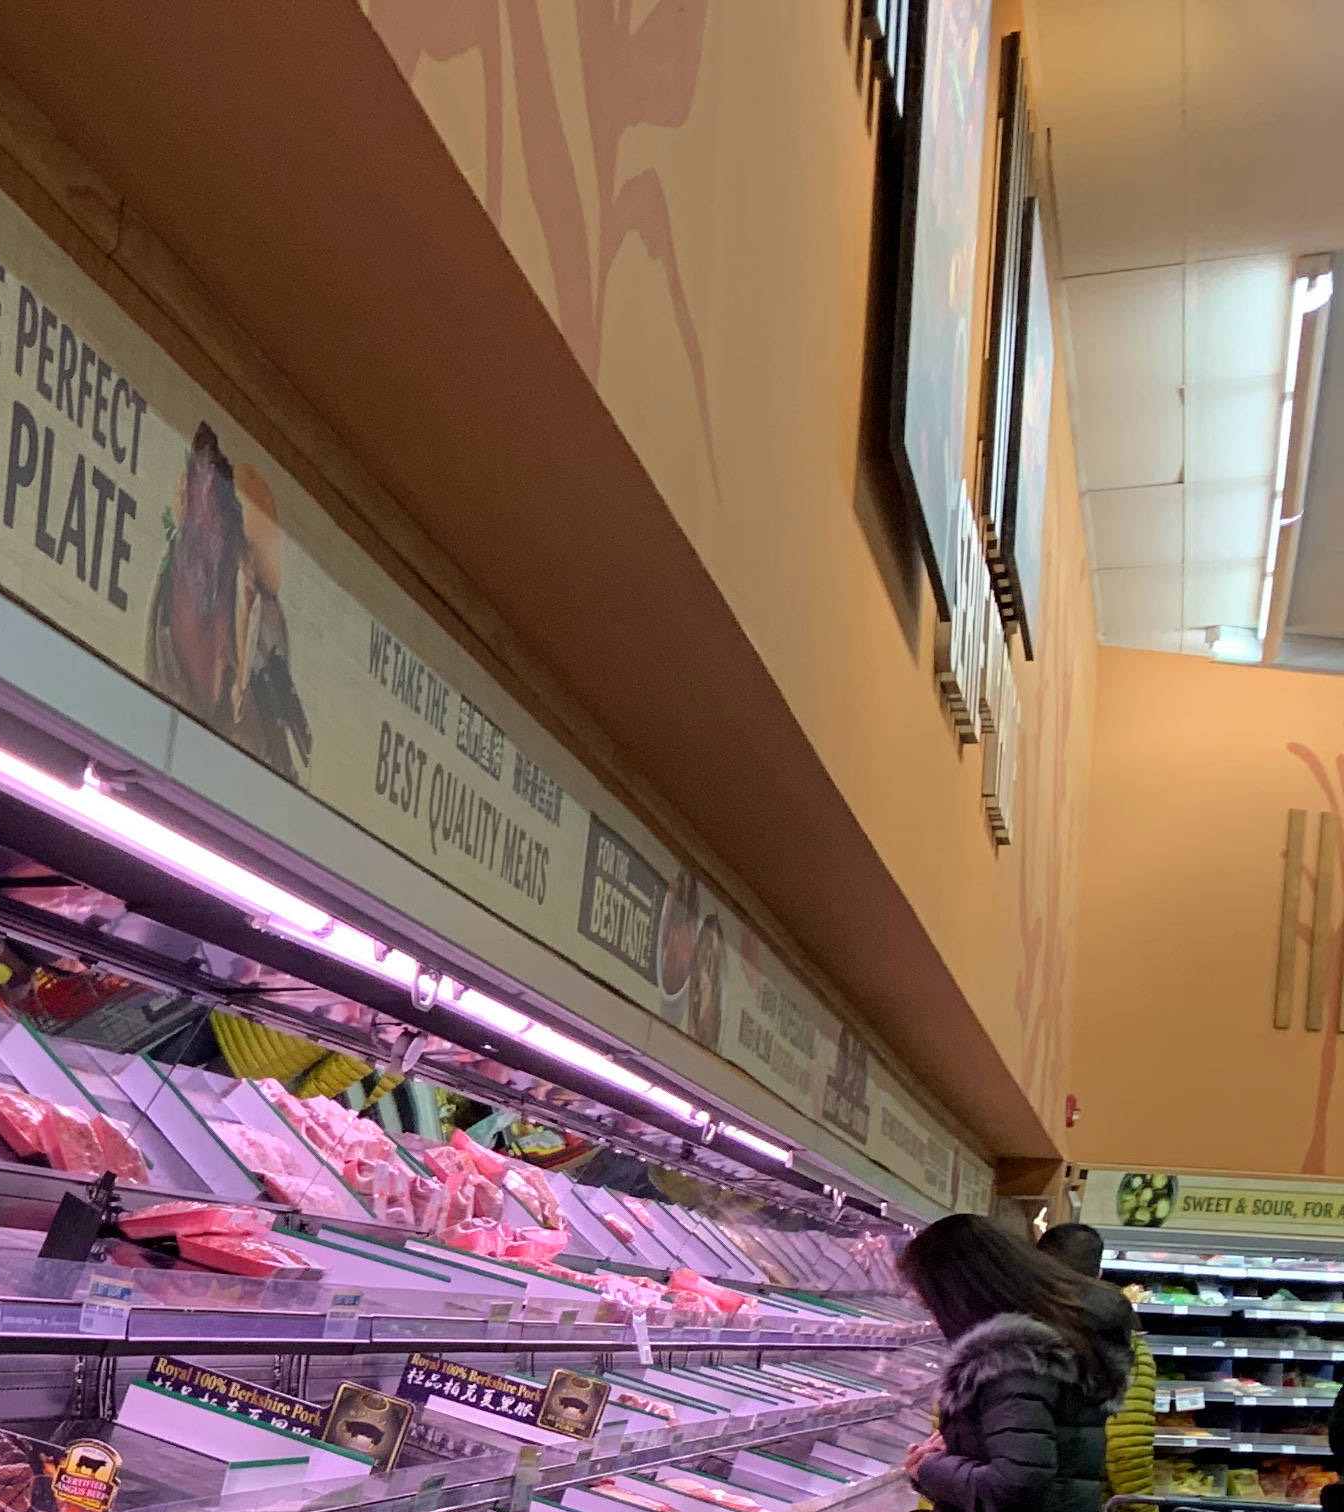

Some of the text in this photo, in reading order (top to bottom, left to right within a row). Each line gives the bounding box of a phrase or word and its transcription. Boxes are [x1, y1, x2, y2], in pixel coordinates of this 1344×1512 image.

[15, 284, 148, 475] PERFECT
[3, 401, 137, 612] PLATE
[368, 620, 450, 735] WE TAKE THE
[375, 720, 427, 819] BEST
[428, 762, 502, 872] QUALITY
[501, 818, 550, 906] MEATS
[596, 836, 615, 875] FOR
[591, 875, 624, 946] BEST
[1182, 1195, 1334, 1219] SWEET & SOUR, FOR
[155, 1357, 323, 1427] Royal 100% Berkshire Pork
[411, 1353, 542, 1401] Royal 100% Berkshire Pork
[55, 1481, 85, 1495] ANGUS
[61, 1474, 107, 1491] CERTIFIED
